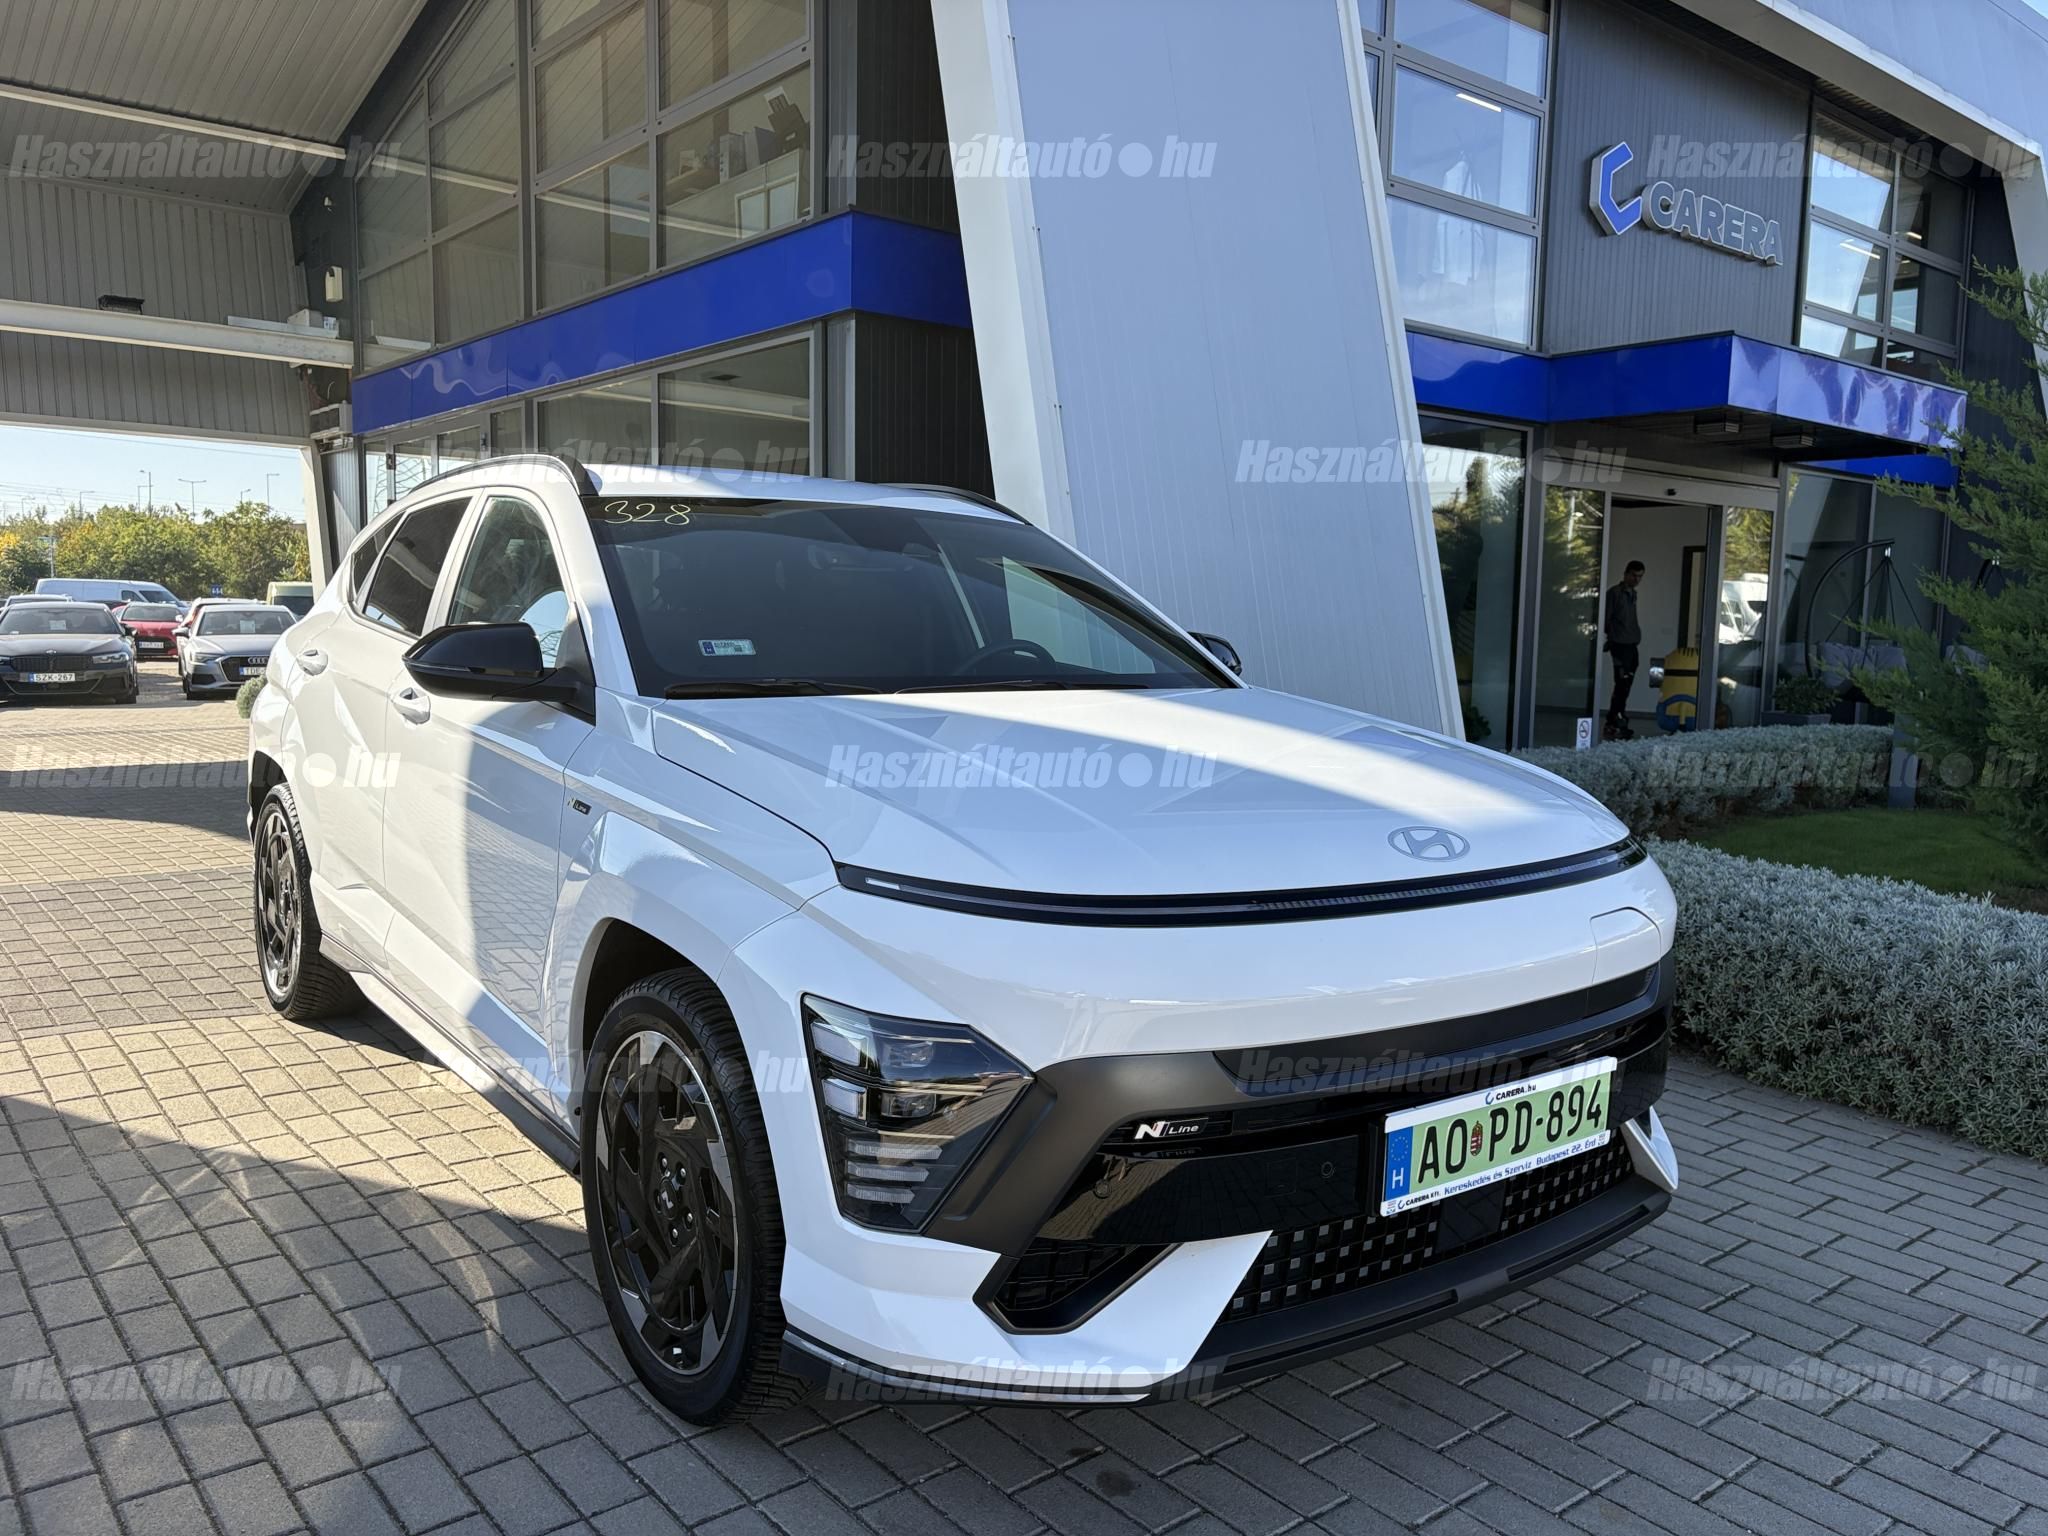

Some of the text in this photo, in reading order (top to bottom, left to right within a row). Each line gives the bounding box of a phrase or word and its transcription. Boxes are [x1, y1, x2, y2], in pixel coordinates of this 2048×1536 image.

[1644, 181, 1784, 266] CARERA
[604, 500, 691, 526] 328
[1496, 1084, 1537, 1100] CARERA.hu
[1134, 1120, 1199, 1139] N Line
[1391, 1167, 1404, 1190] H
[1405, 1194, 1429, 1206] CARERA
[1444, 1175, 1491, 1196] Kereskedés
[1504, 1161, 1531, 1176] Szerviz
[1536, 1148, 1569, 1166] Budapest
